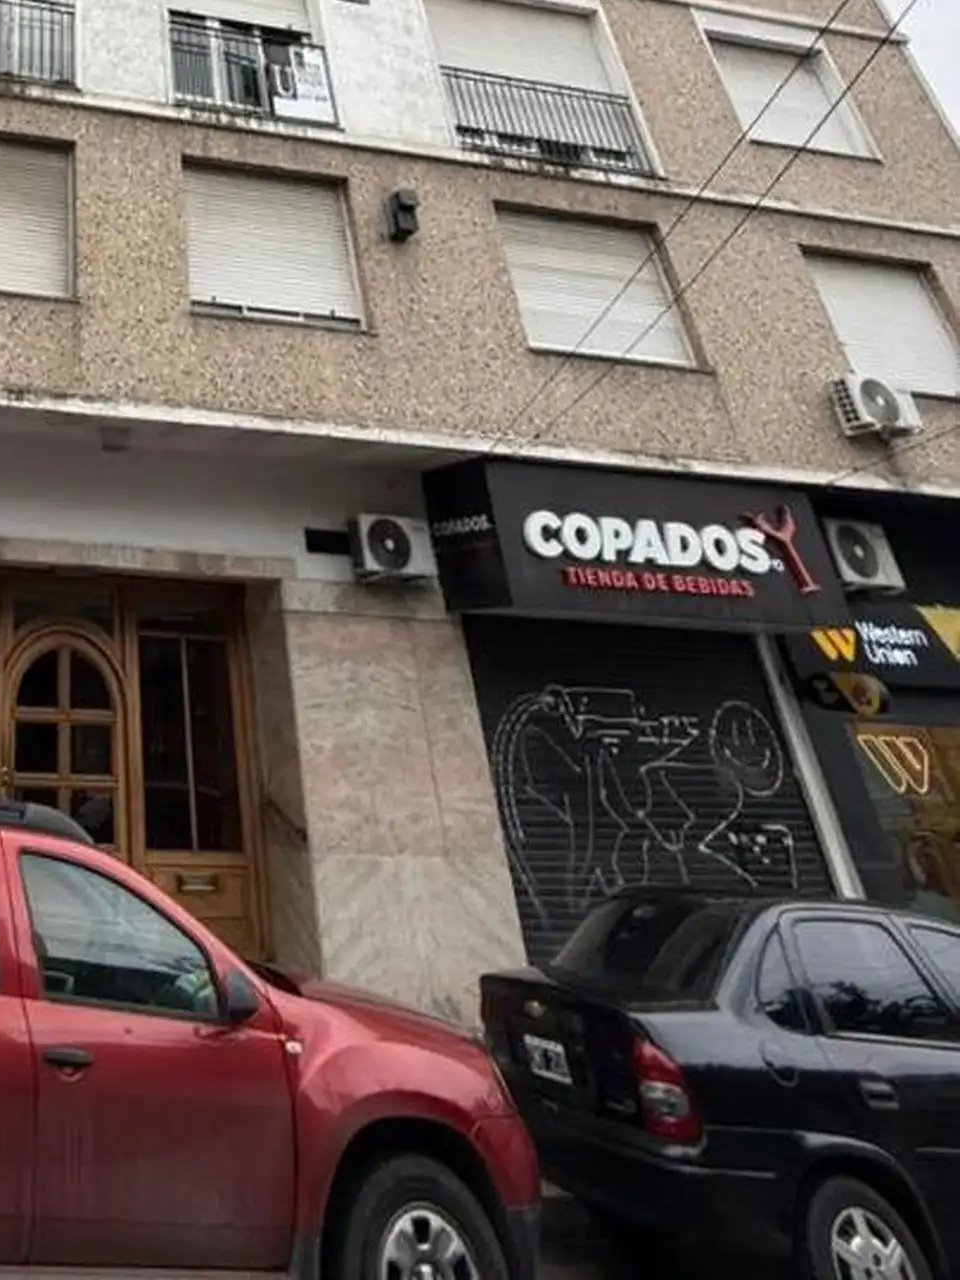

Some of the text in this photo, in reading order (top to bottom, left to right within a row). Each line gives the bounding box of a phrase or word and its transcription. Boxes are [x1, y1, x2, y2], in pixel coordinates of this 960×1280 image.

[566, 566, 755, 597] TIENDA DE BEBIDAS
[854, 619, 930, 648] Western
[863, 642, 918, 666] Union
